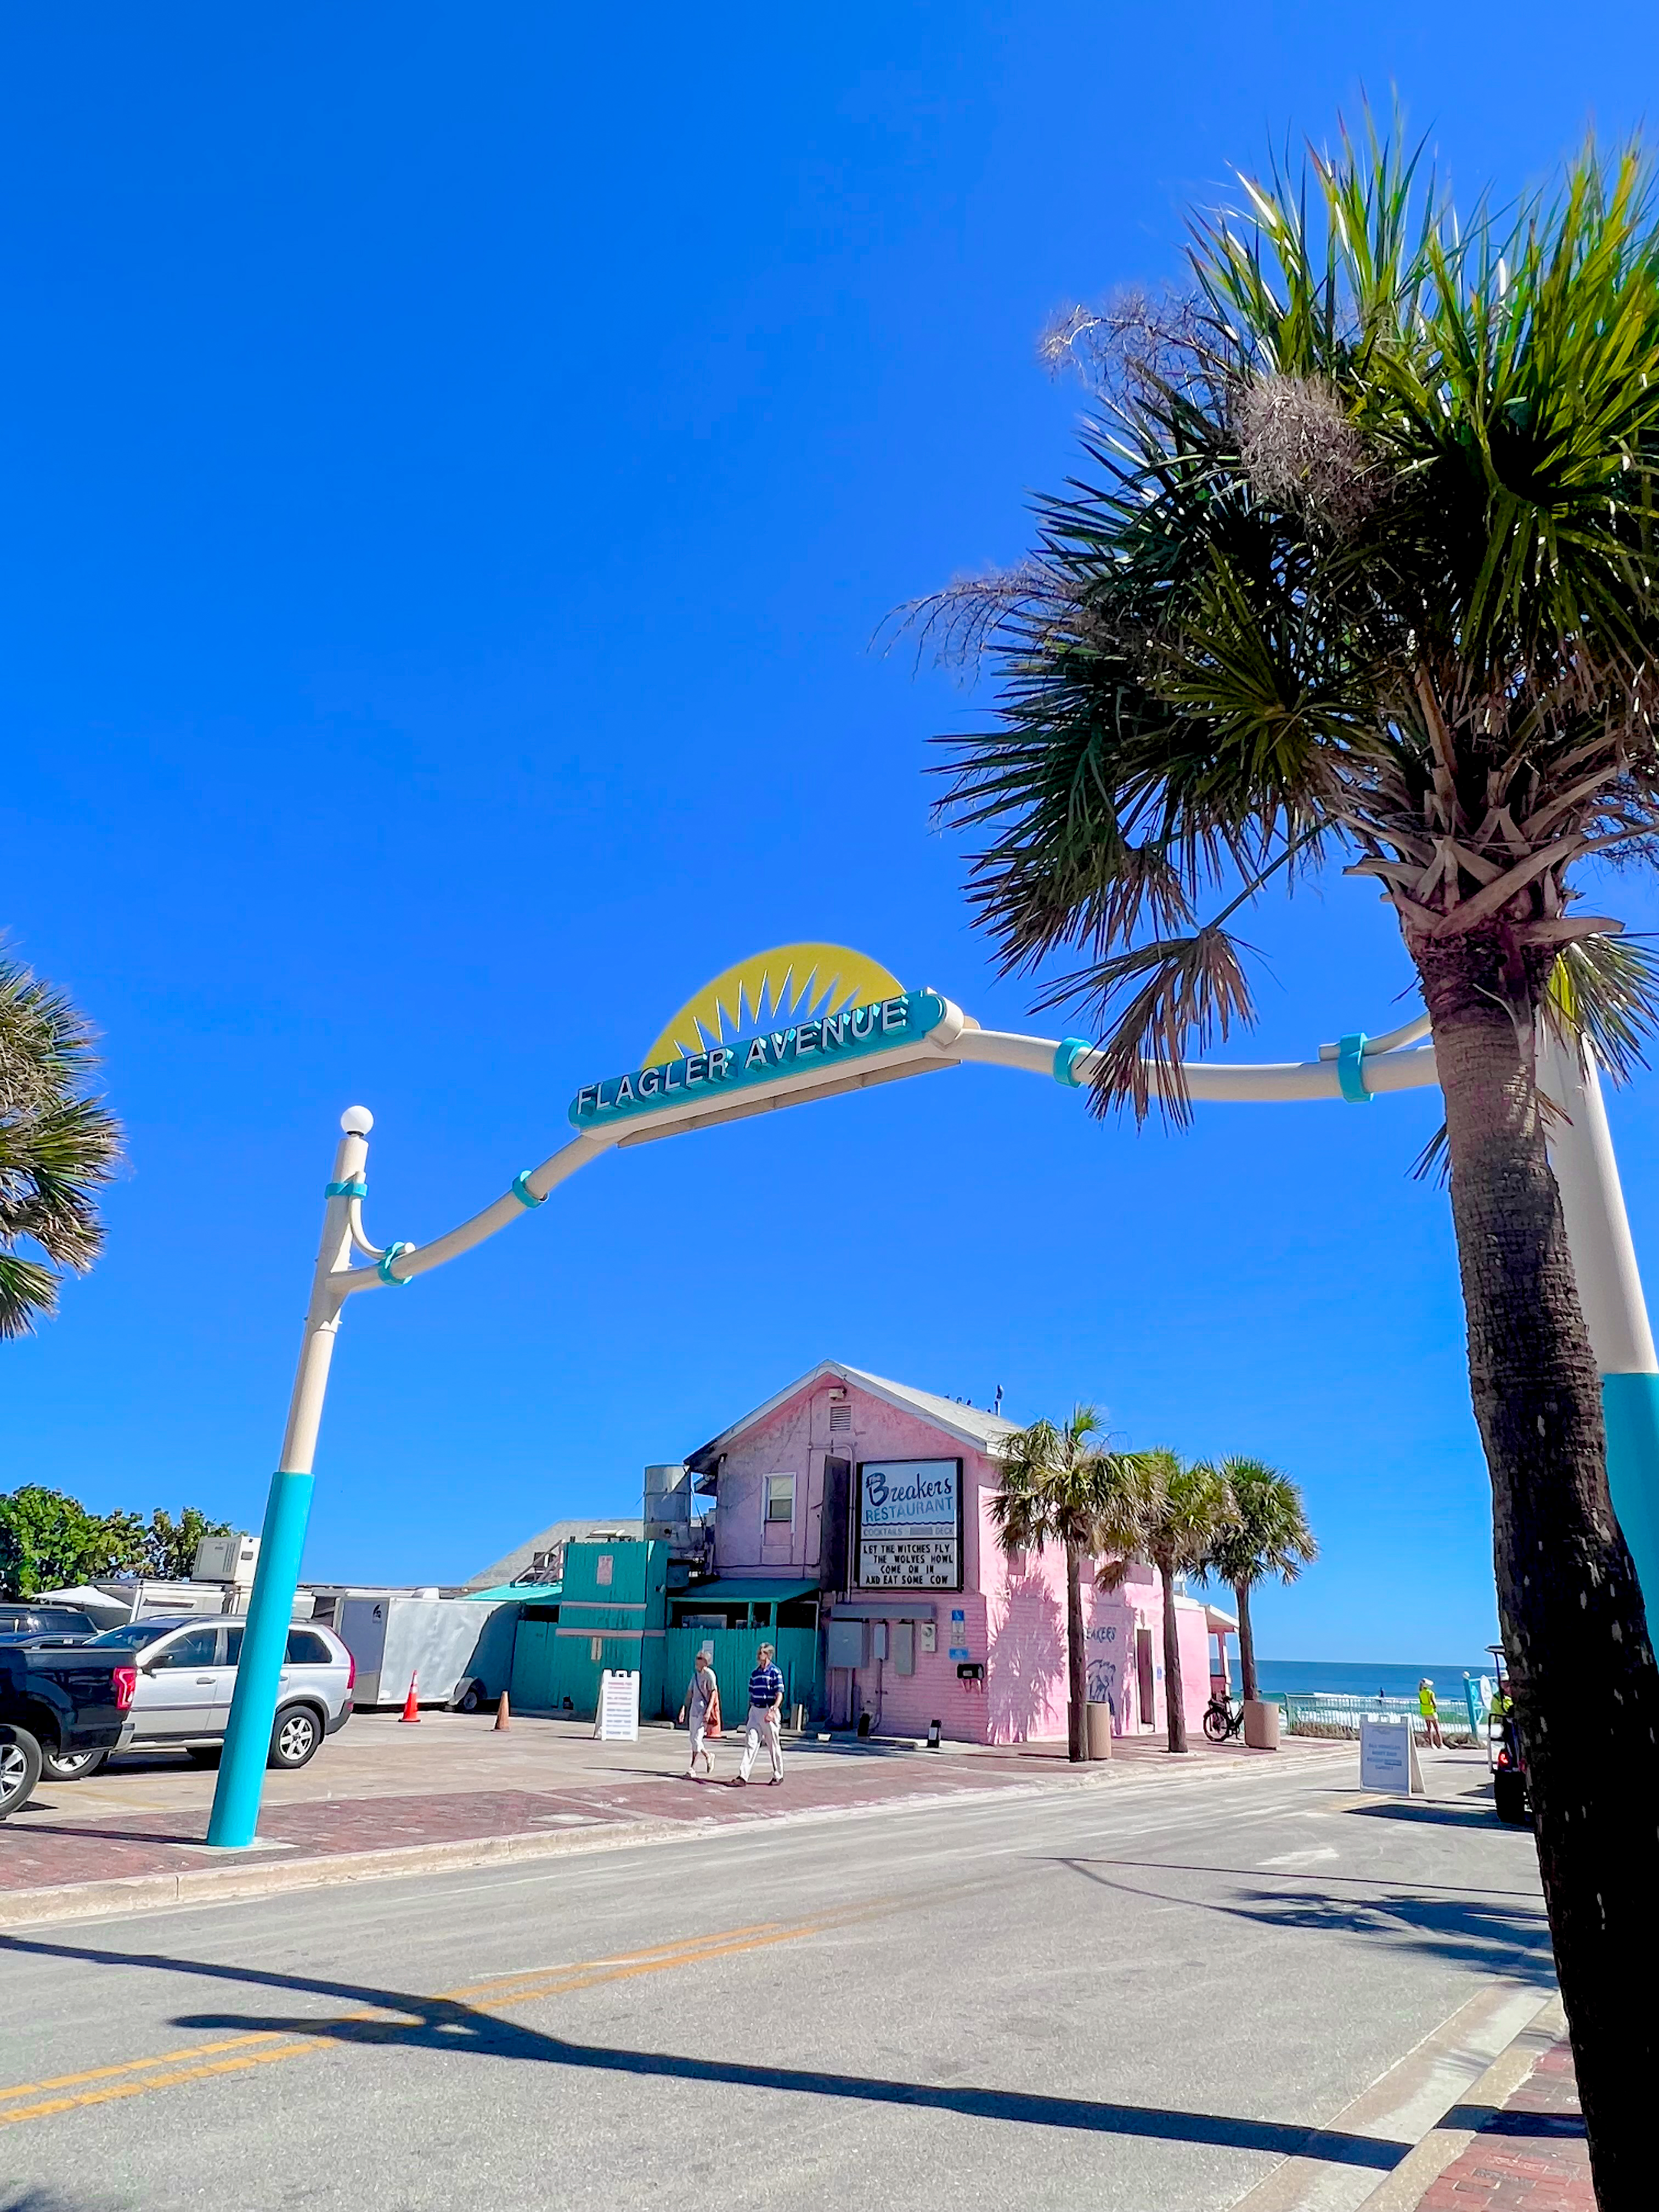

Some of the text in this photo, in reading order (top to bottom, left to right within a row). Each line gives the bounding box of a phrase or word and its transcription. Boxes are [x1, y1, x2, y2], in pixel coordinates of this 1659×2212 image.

[576, 994, 909, 1116] FLAGLER AVENUE
[866, 1472, 952, 1506] Breakers
[866, 1497, 953, 1522] RESTAURANT
[864, 1527, 903, 1536] COCKTAILS
[864, 1544, 950, 1554] LET THE WITCHES FLY
[874, 1555, 887, 1564] THE
[931, 1554, 953, 1564] HOWL
[880, 1565, 934, 1574] COME ON IN
[866, 1575, 949, 1584] AND EAT SOME COW
[1085, 1626, 1116, 1643] EAKERS
